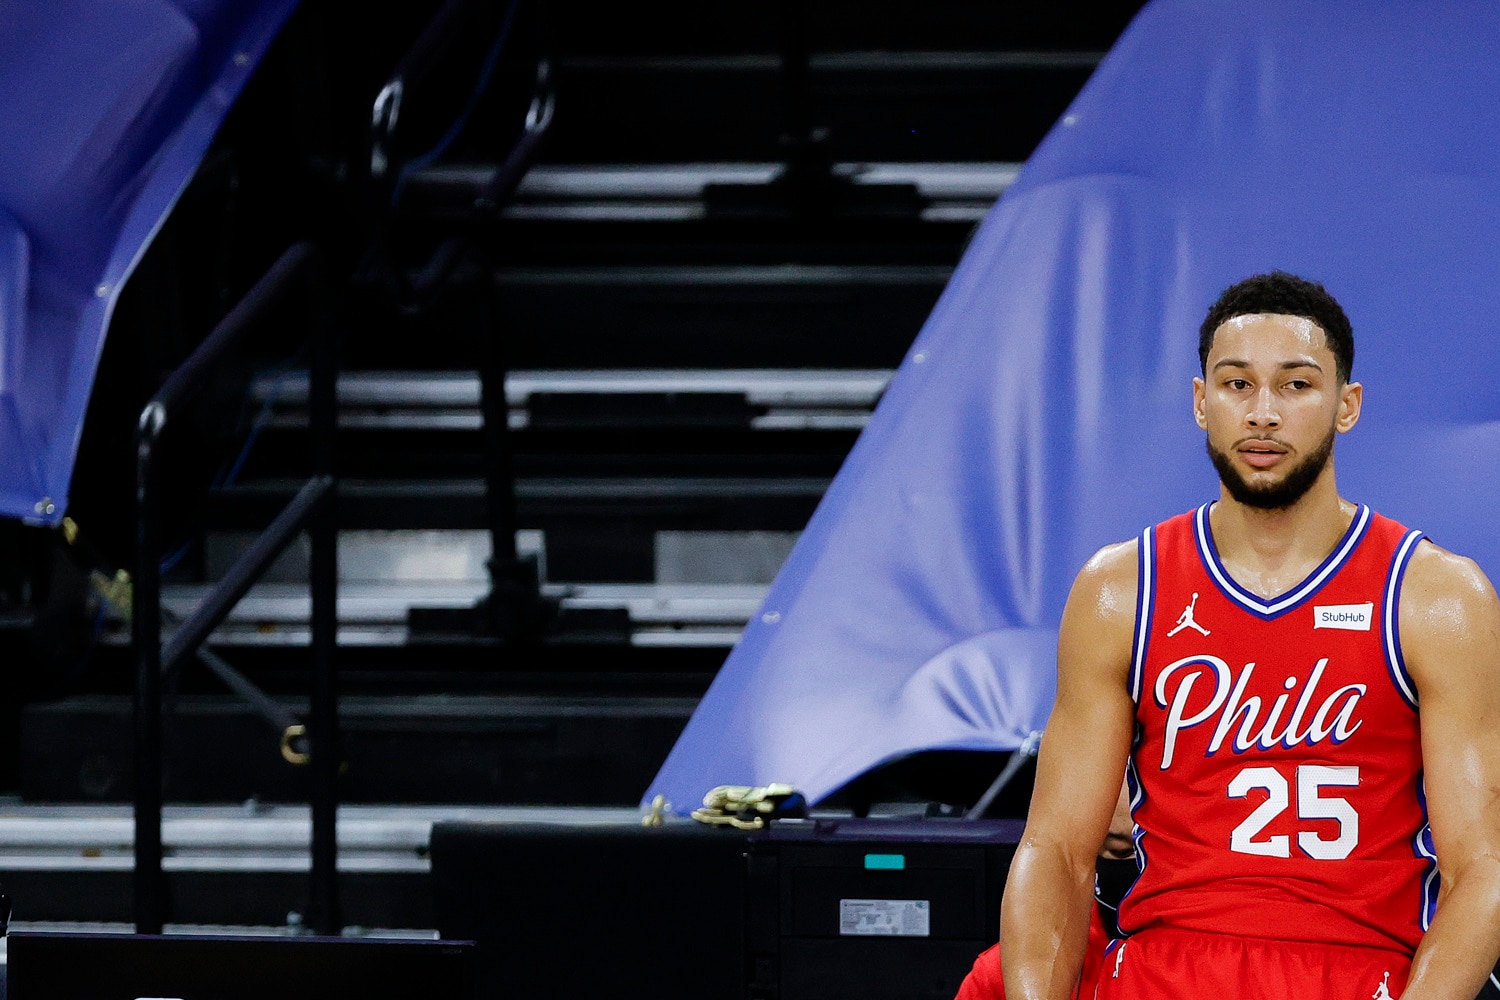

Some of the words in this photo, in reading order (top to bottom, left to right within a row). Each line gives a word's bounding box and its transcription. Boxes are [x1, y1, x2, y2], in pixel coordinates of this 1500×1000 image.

[1321, 611, 1366, 623] StubHub
[1154, 654, 1367, 771] Phila
[1227, 765, 1360, 860] 25
